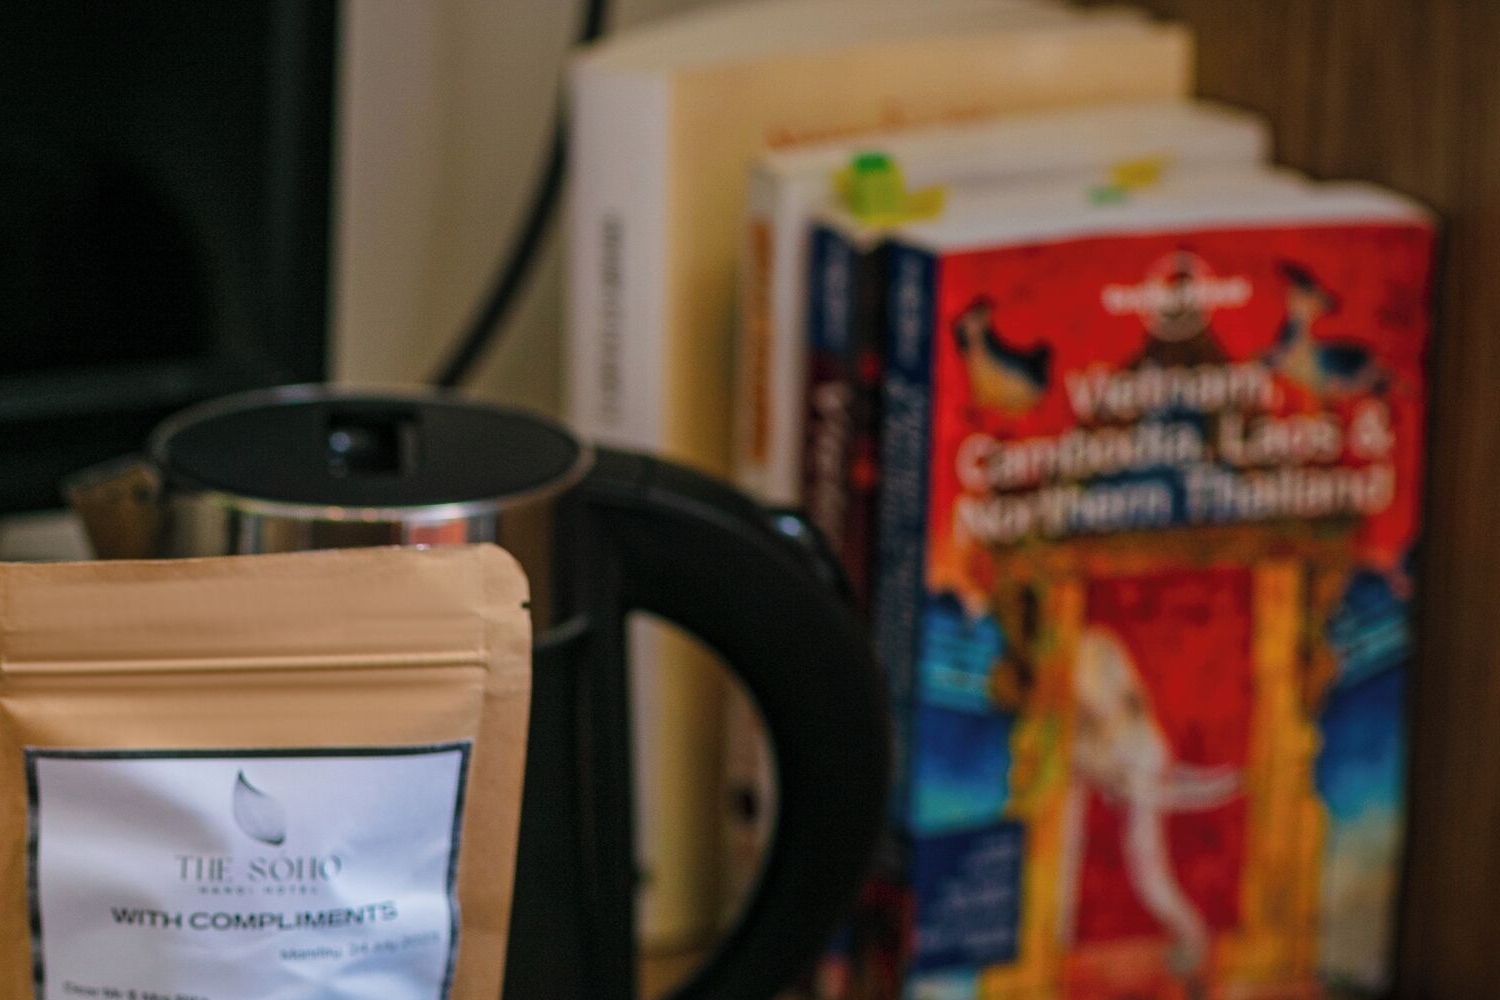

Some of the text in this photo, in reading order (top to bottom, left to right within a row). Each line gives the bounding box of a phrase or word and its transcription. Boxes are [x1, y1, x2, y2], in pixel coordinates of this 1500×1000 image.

[1185, 463, 1396, 522] Thailand
[174, 853, 342, 882] THE SOHO
[110, 900, 398, 931] WITH COMPLIMENTS
